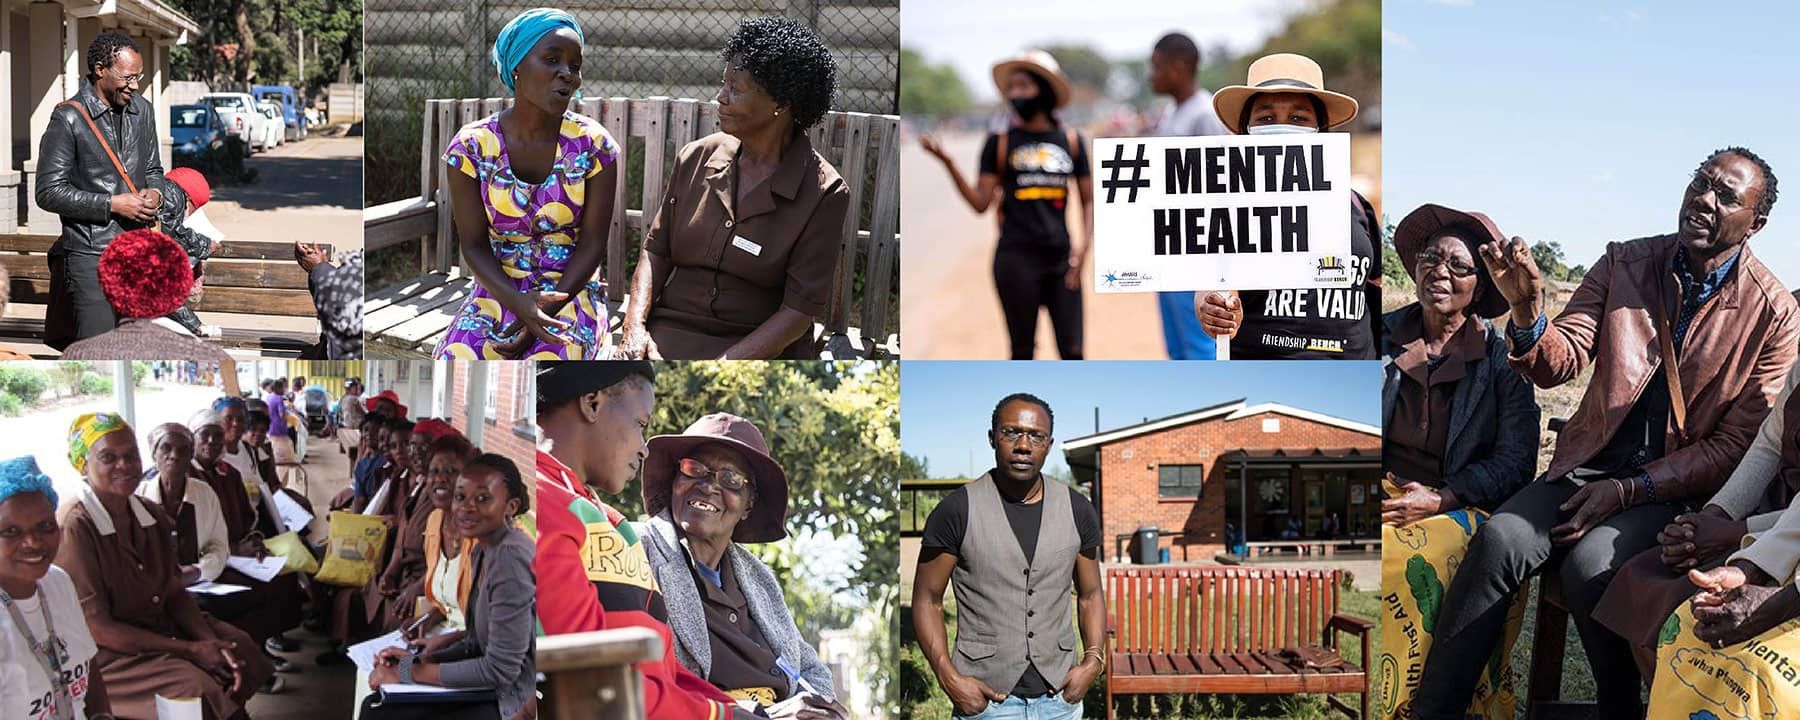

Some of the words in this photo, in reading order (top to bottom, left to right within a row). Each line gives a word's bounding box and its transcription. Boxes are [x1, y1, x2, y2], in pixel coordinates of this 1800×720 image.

[1101, 144, 1150, 203] #
[1165, 144, 1331, 195] MENTAL
[1153, 205, 1309, 255] HEALTH
[1263, 289, 1308, 317] ARE
[1316, 288, 1366, 320] VALID
[1262, 333, 1307, 350] FRIENDSHIP
[1310, 338, 1341, 350] BENCH
[1384, 592, 1408, 621] Aid
[1402, 621, 1421, 659] First
